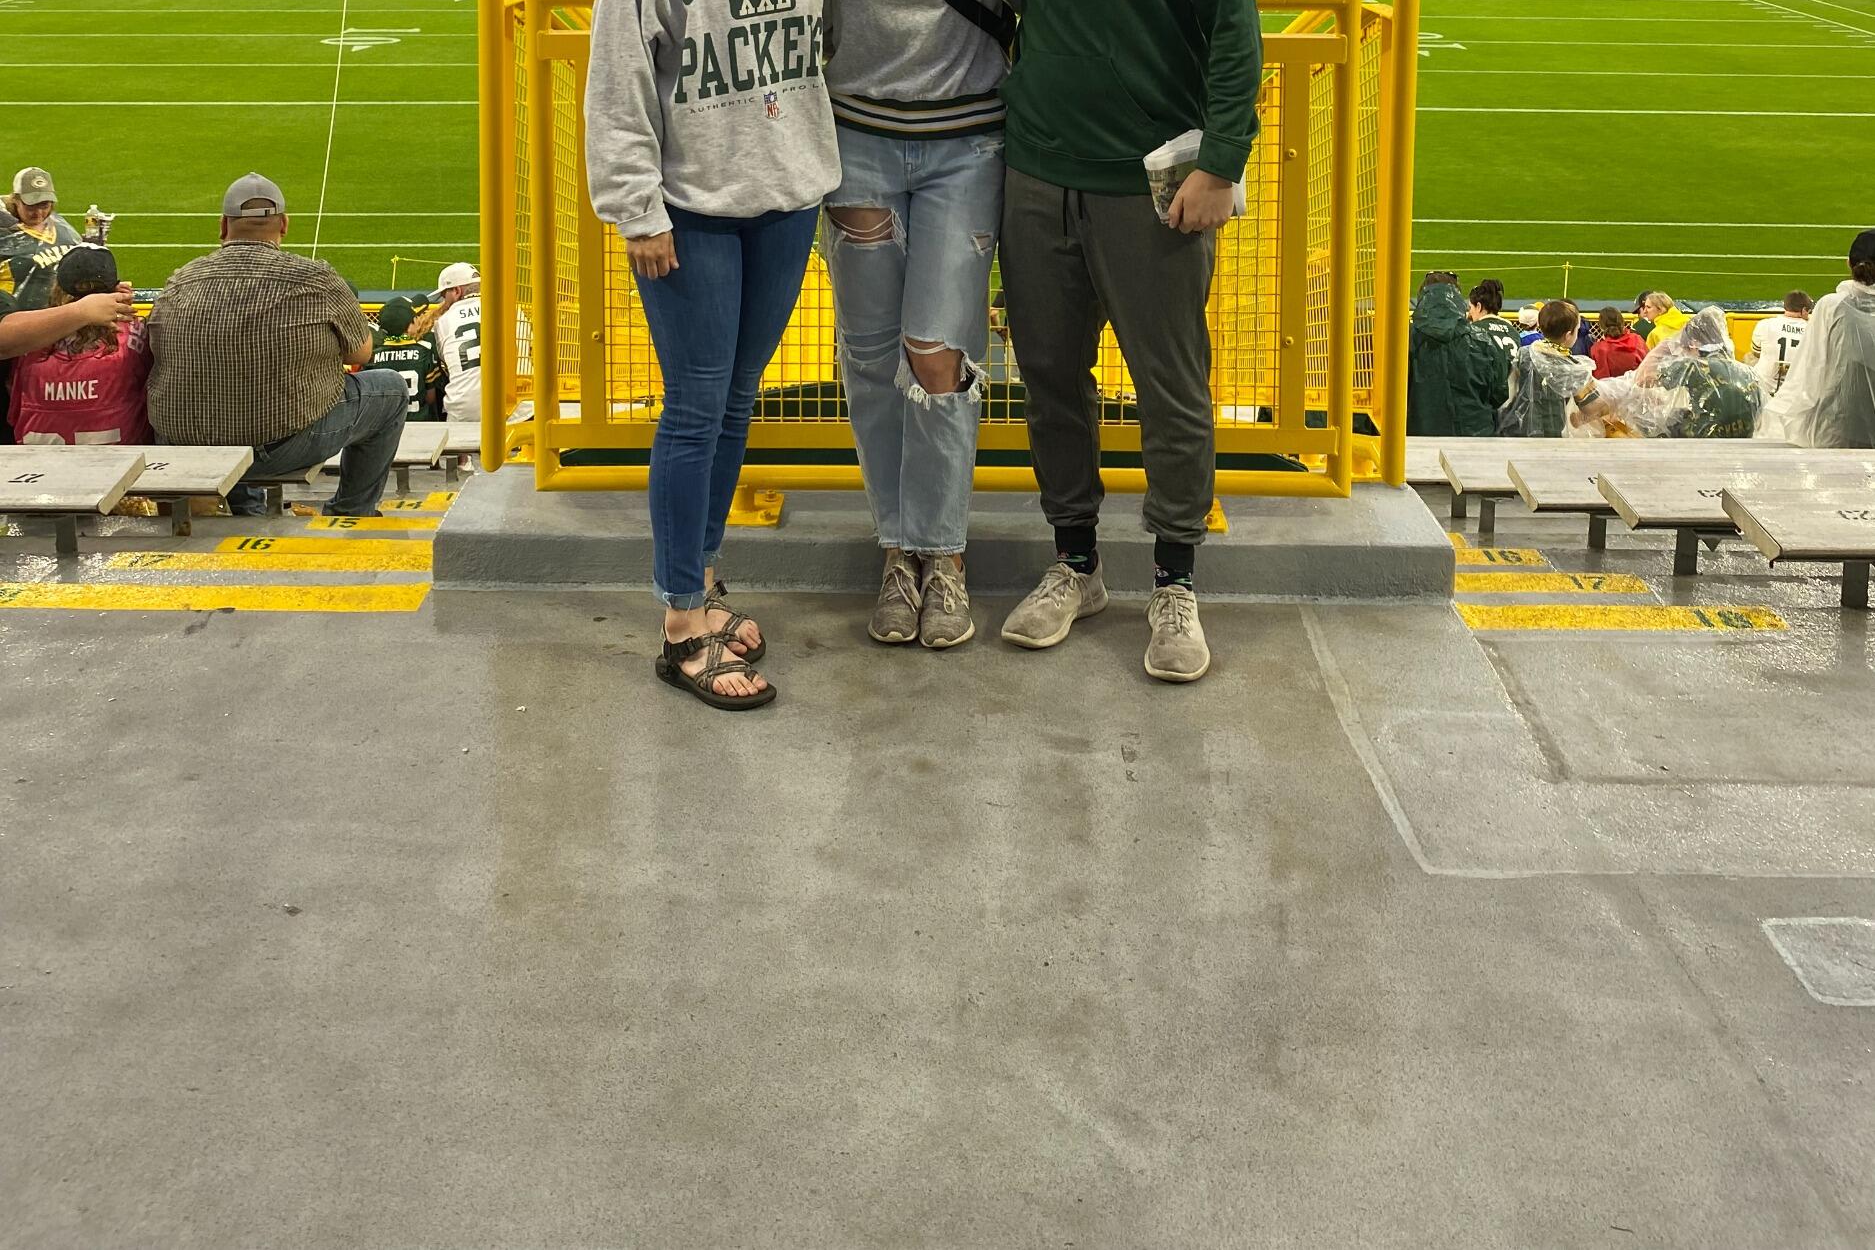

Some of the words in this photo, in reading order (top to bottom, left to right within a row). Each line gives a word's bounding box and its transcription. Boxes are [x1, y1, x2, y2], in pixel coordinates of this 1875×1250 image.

[689, 96, 756, 114] AUTHENTIC
[782, 84, 806, 94] PRO
[373, 349, 420, 363] MATTHEWS
[44, 379, 99, 401] MANKE
[328, 517, 361, 528] 15
[236, 537, 276, 550] 16
